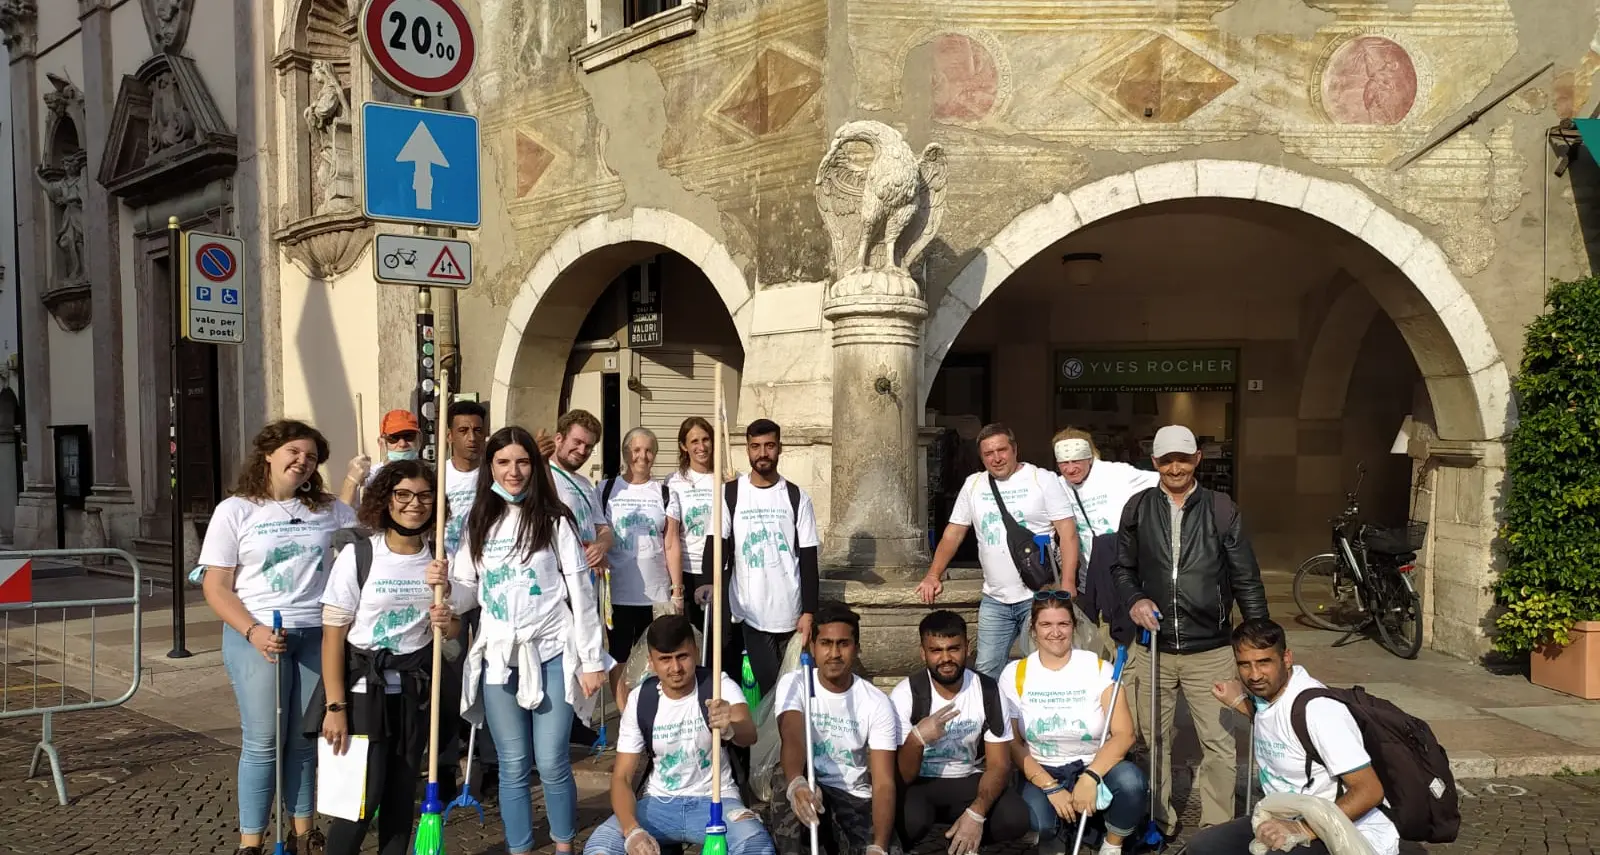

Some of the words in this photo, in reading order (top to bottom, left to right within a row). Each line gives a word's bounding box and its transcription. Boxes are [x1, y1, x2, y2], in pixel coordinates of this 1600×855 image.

[436, 21, 443, 37] t
[200, 288, 209, 299] P
[196, 316, 215, 324] vale
[210, 328, 234, 337] posti
[633, 323, 657, 333] VALORI
[632, 333, 658, 342] BOLLATI
[1090, 361, 1138, 374] YVES
[1147, 359, 1232, 372] ROCHER
